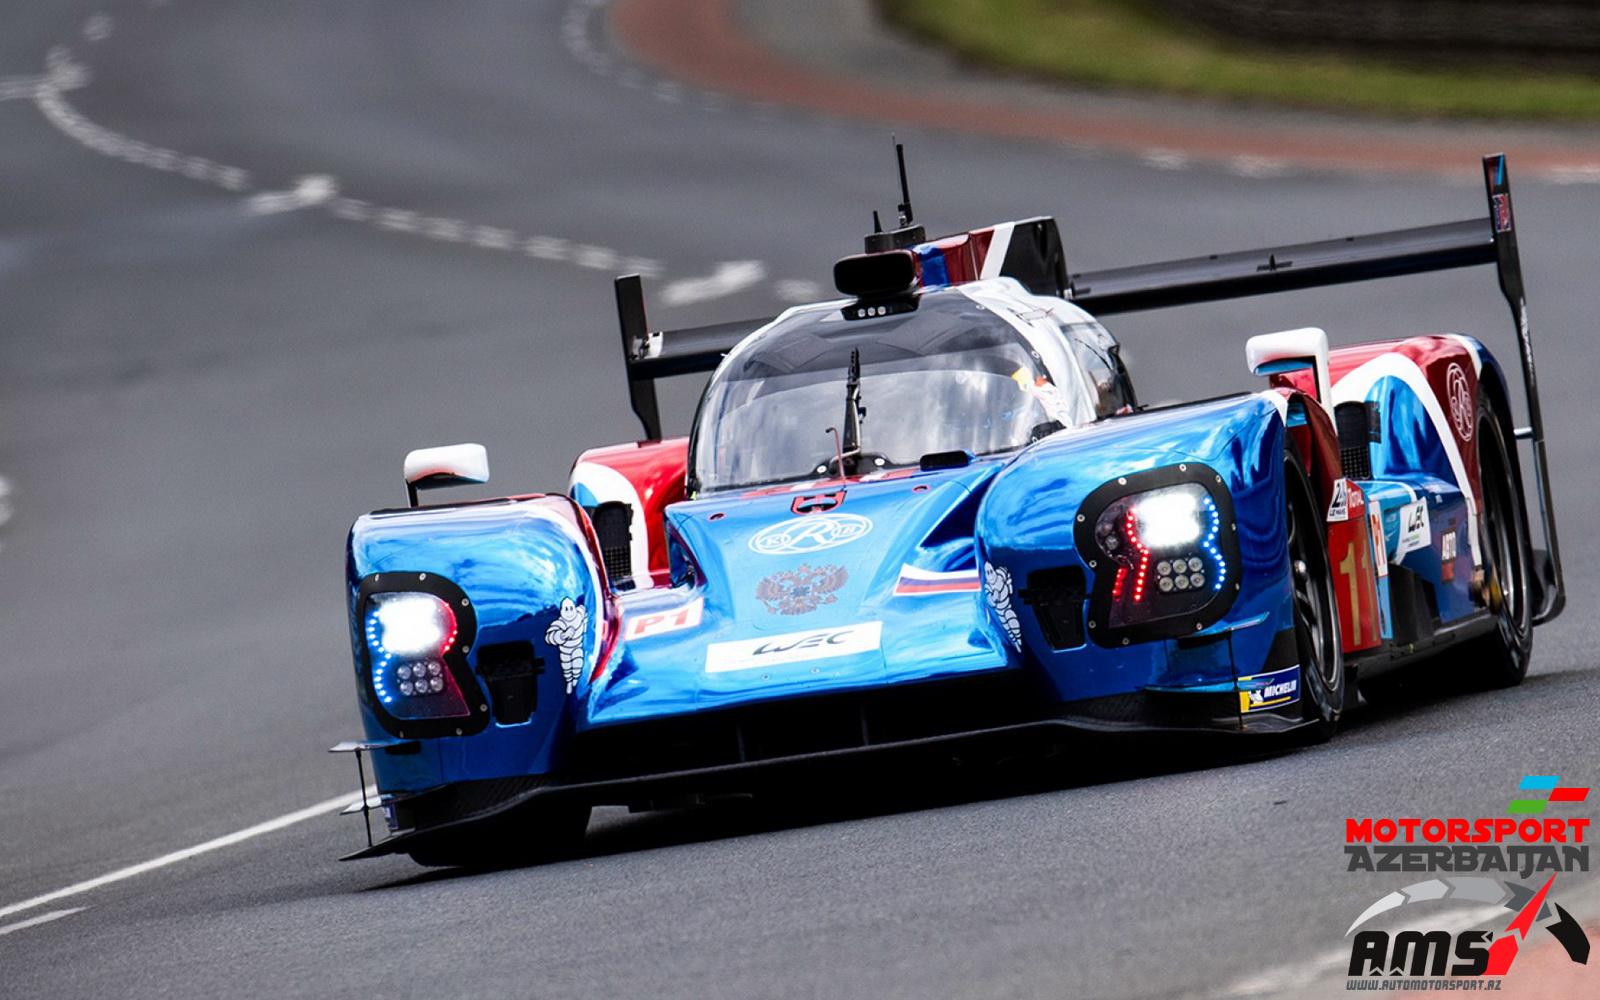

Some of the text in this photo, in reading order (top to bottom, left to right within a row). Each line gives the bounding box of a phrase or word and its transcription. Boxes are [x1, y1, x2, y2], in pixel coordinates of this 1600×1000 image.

[634, 607, 690, 634] P1
[752, 630, 855, 656] WEC
[1263, 679, 1297, 699] MICHELIN
